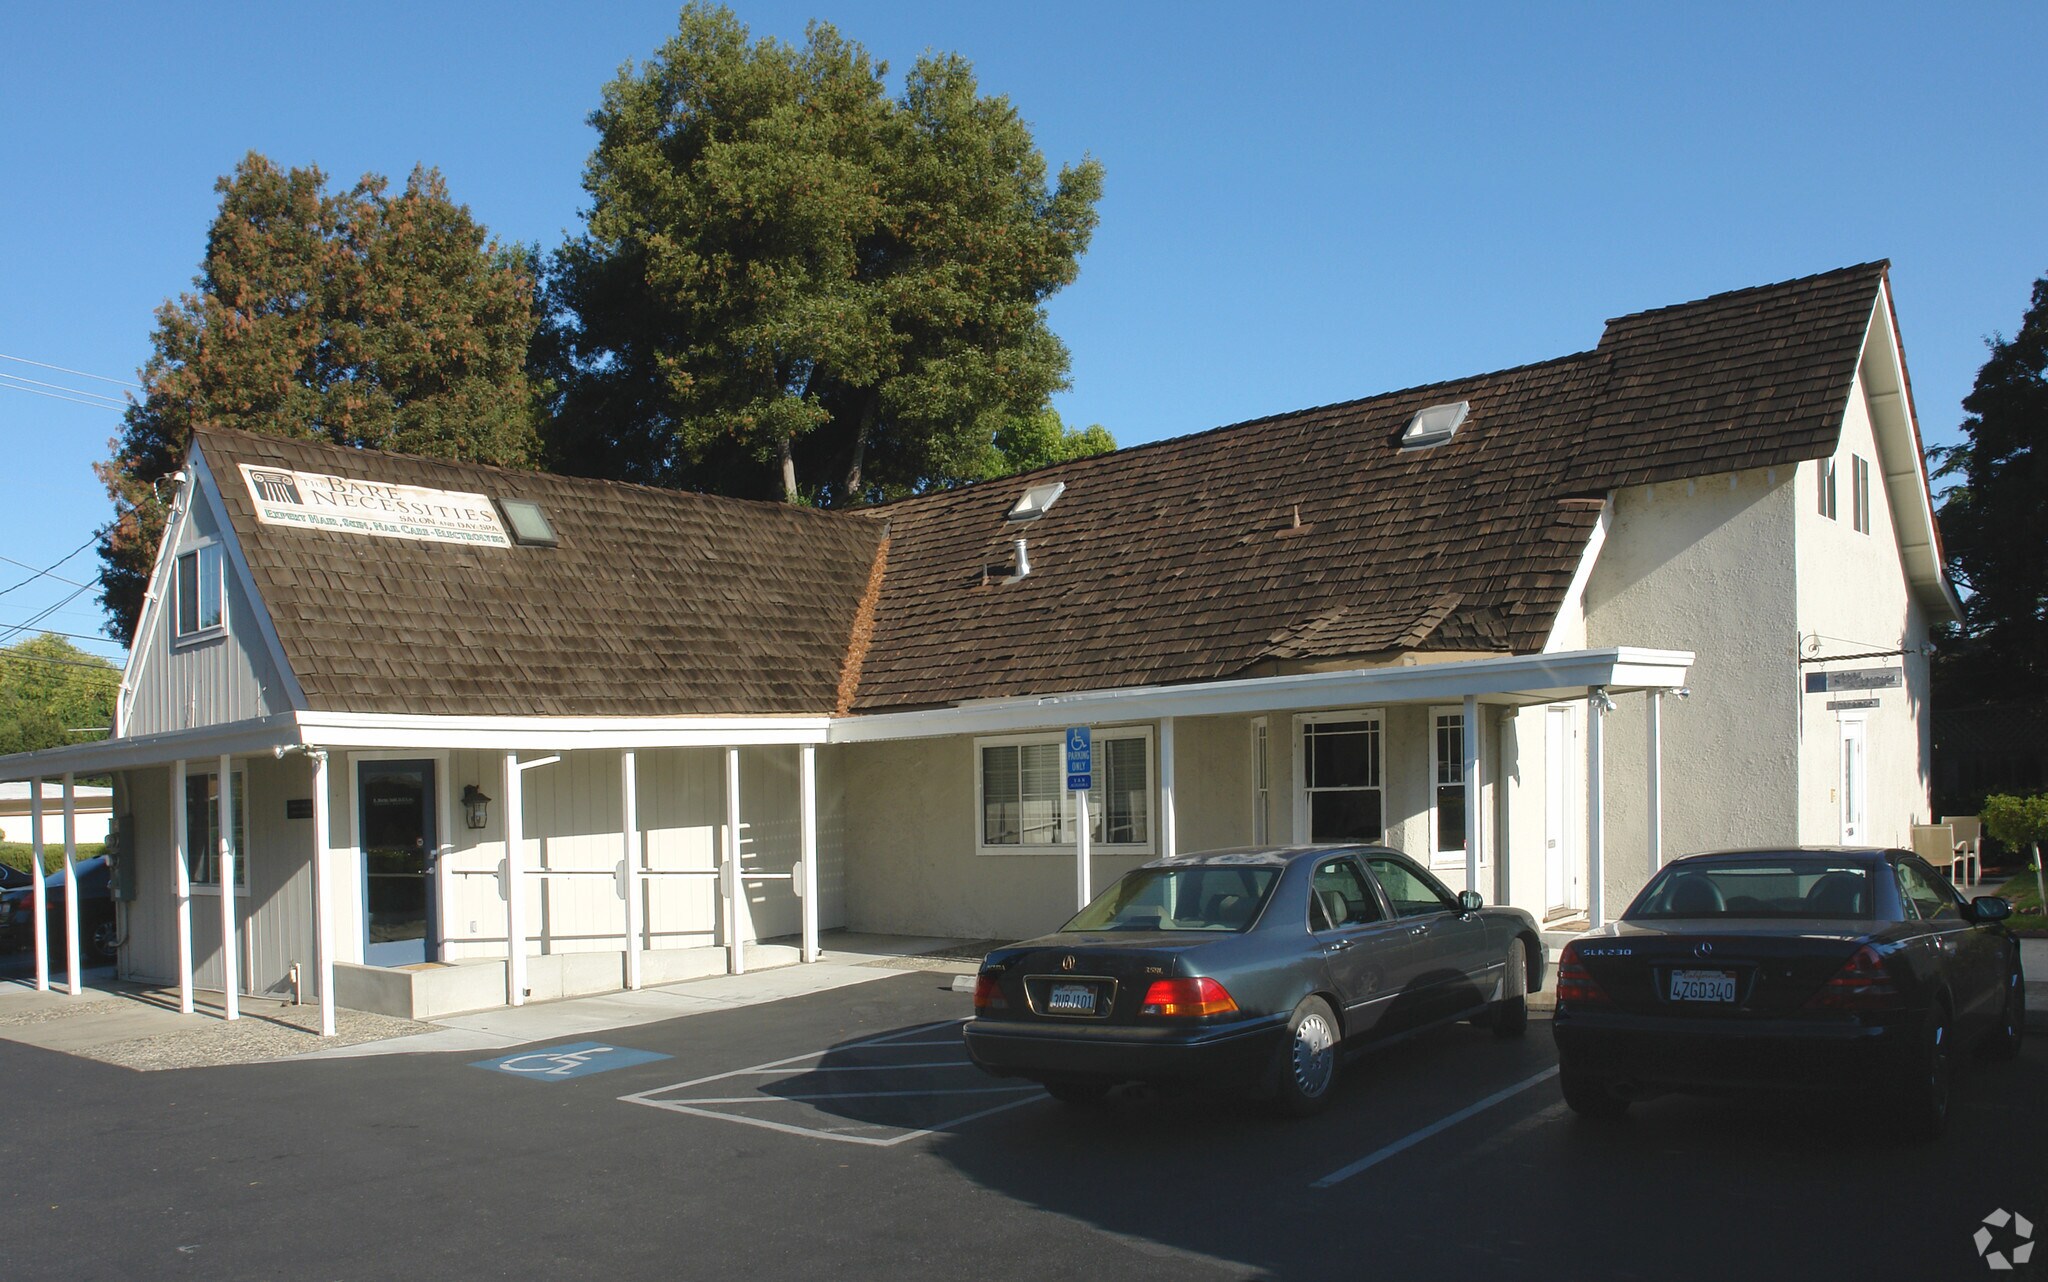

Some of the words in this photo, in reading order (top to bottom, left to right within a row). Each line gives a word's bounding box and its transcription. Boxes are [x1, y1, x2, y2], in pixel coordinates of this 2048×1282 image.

[301, 478, 325, 489] THE
[325, 476, 401, 500] BARE
[311, 490, 493, 522] NECESSITIES
[264, 508, 306, 521] EXPERT
[373, 522, 400, 532] NAIL
[401, 525, 430, 536] CARE
[435, 528, 506, 544] ELECTROLYSIS
[399, 515, 435, 525] SALON
[457, 521, 477, 530] DAY
[480, 524, 499, 532] SPA
[1068, 750, 1090, 760] PARKING
[1072, 761, 1086, 771] ONLY
[1672, 981, 1733, 999] 4ZGD340
